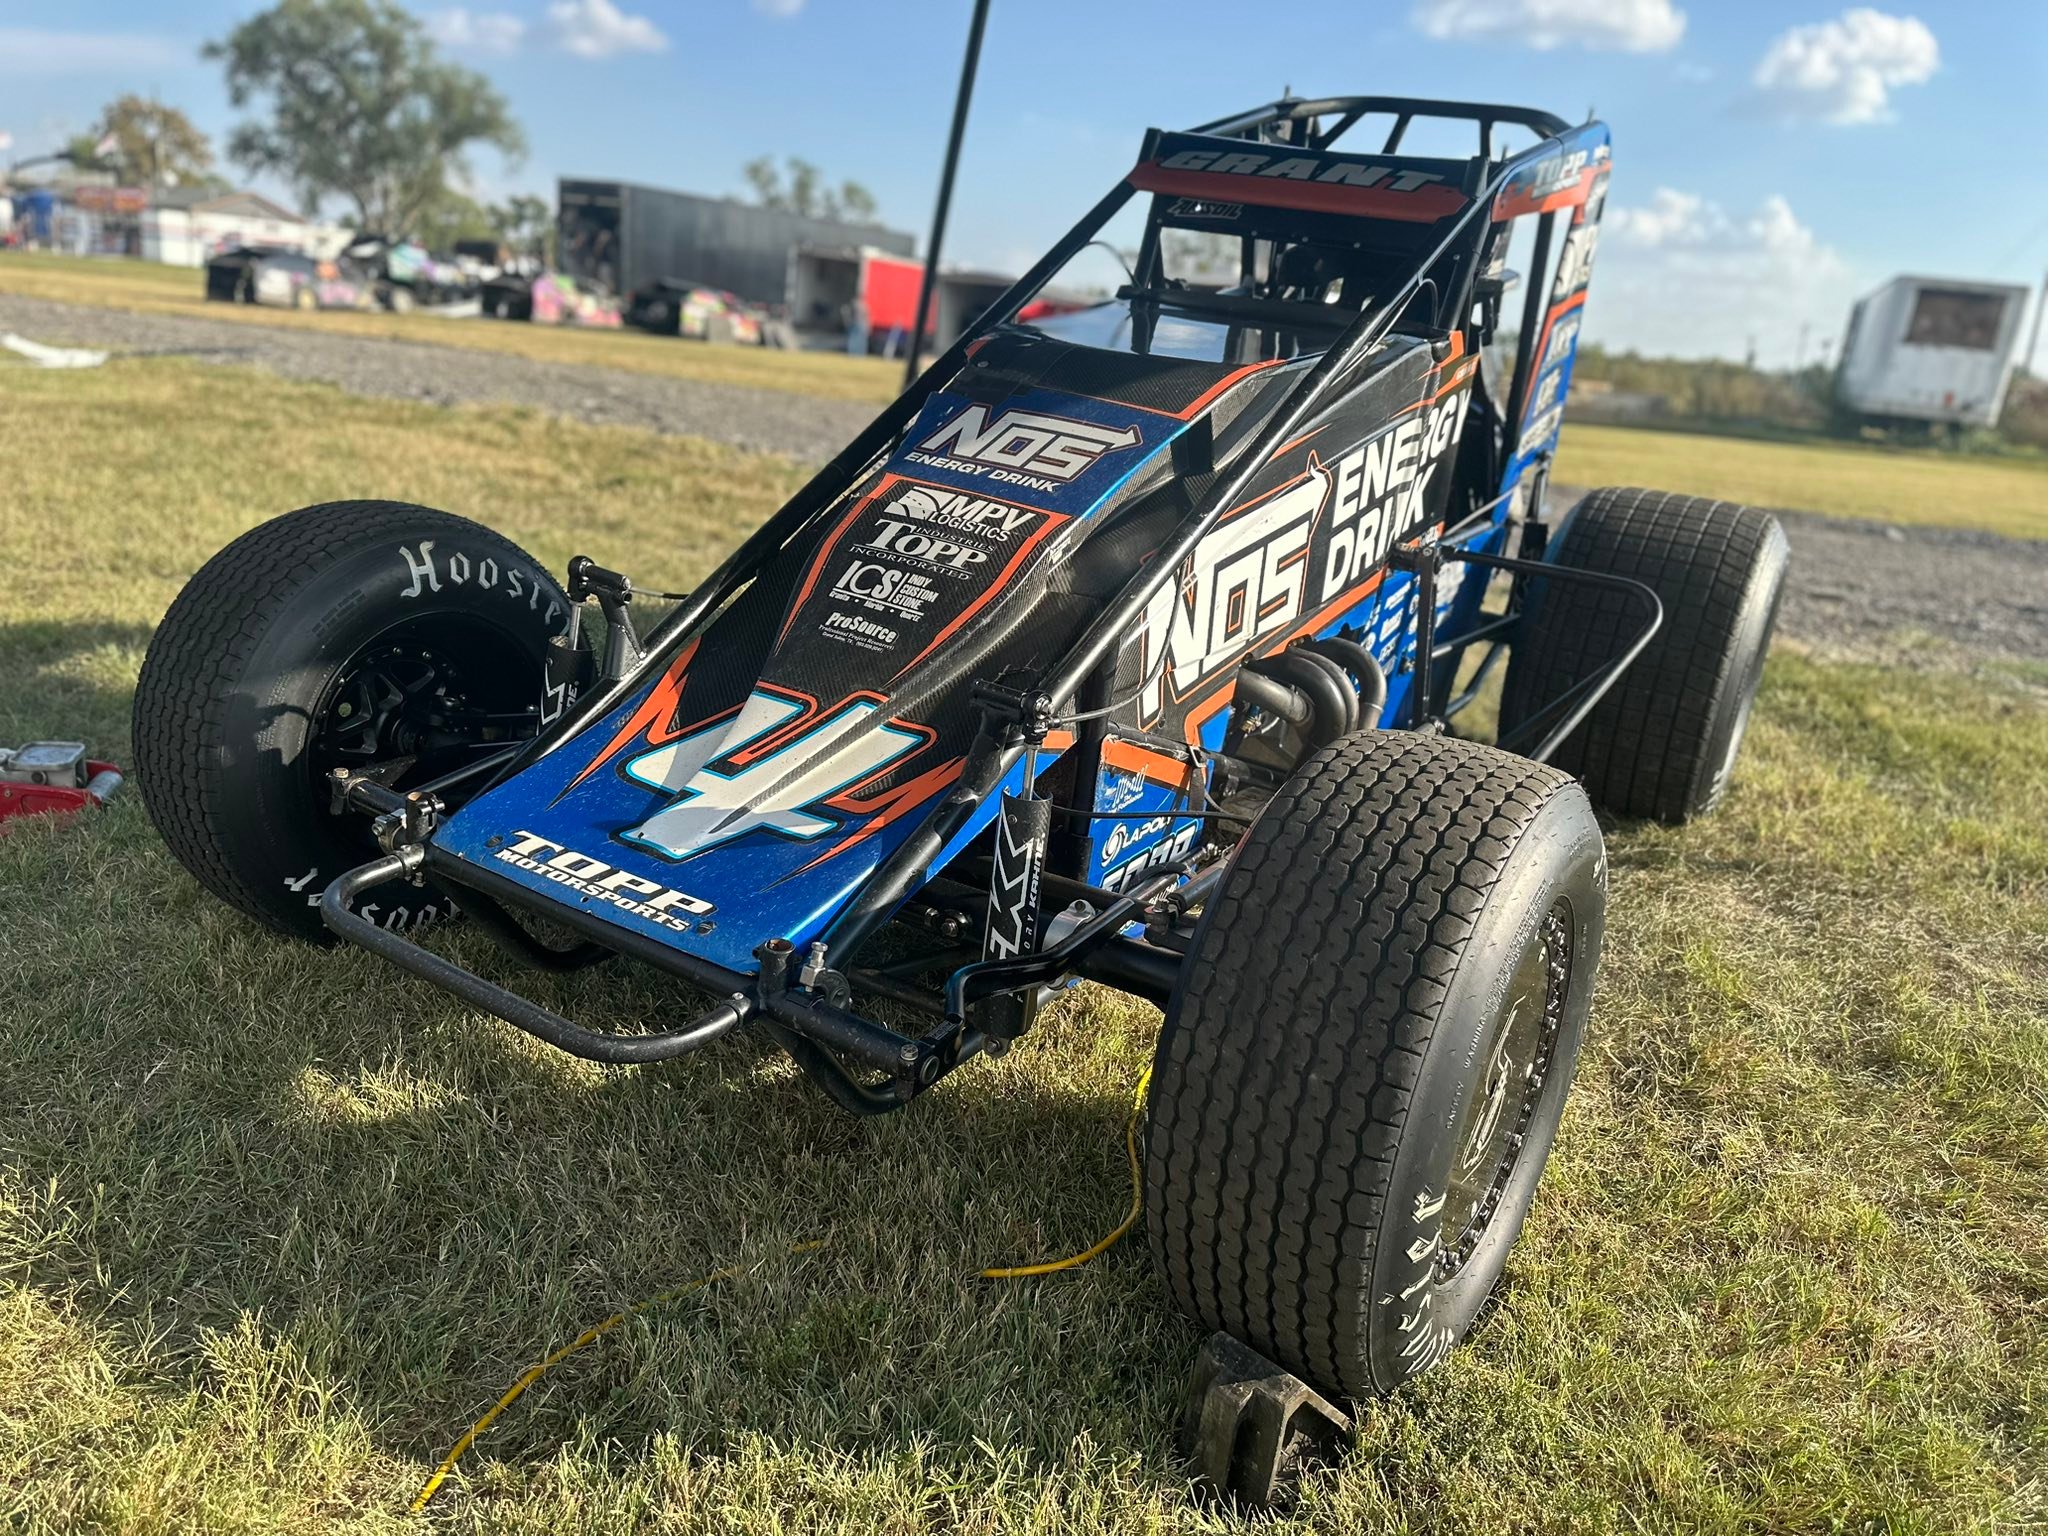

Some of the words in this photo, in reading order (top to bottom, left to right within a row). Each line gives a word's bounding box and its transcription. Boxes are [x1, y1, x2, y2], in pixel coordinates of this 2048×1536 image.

[1160, 151, 1445, 192] GRANT
[919, 404, 1143, 480] NOS
[904, 451, 991, 475] ENERGY
[988, 469, 1061, 493] DRINK
[928, 511, 1011, 542] LOGISTICS
[940, 495, 1036, 532] MPV
[865, 518, 988, 569] TOPP
[915, 526, 995, 551] INDUSTRIES
[835, 560, 903, 599] ICS
[849, 546, 970, 580] INCORPORATED
[907, 573, 933, 588] INDY
[893, 594, 924, 610] STONE
[900, 583, 939, 603] CUSTOM
[1142, 464, 1329, 719] NOS
[825, 612, 897, 643] ProSource
[616, 688, 927, 861] 4
[494, 848, 691, 932] MOTORSPORTS
[507, 829, 716, 915] TOPP
[1463, 1016, 1488, 1070] WARNING
